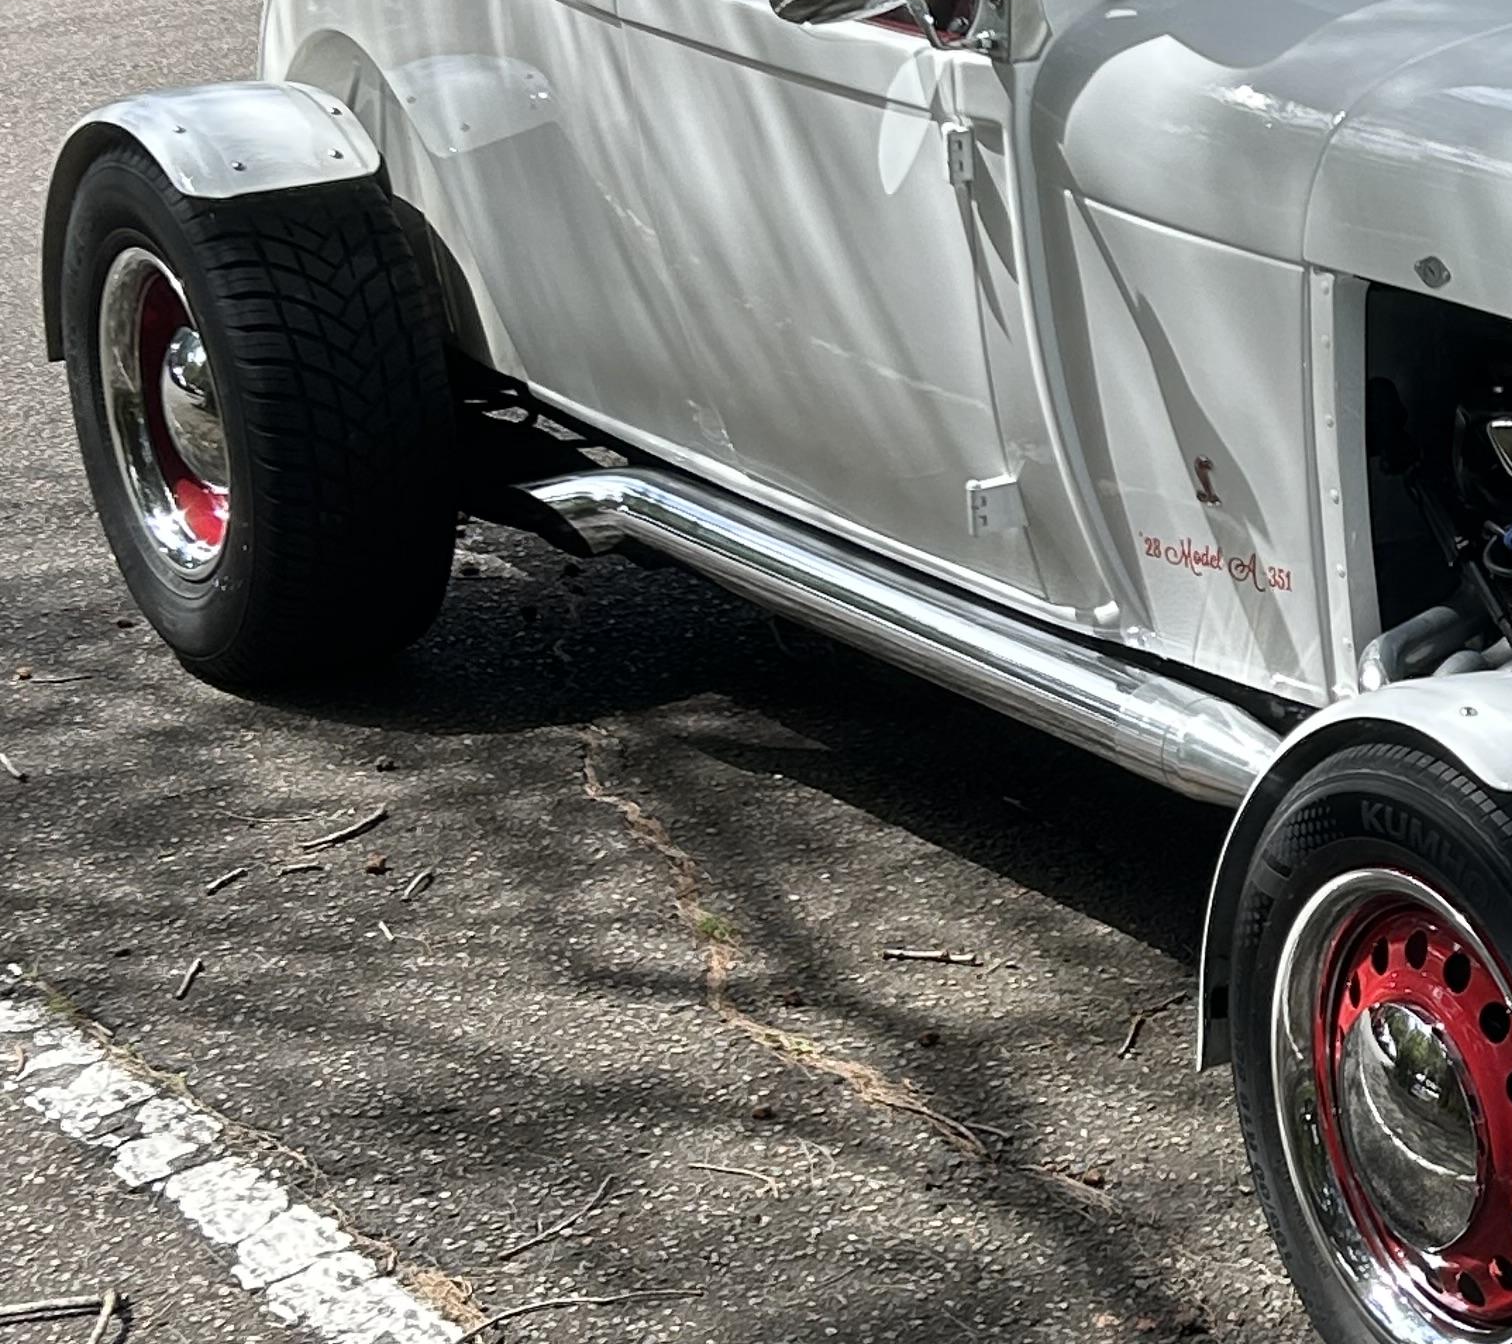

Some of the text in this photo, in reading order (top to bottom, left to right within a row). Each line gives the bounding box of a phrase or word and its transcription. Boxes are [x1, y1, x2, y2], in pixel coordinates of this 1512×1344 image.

[1165, 537, 1223, 576] Model
[1228, 554, 1265, 592] A
[1267, 566, 1292, 592] 351
[1360, 799, 1491, 911] KUMHO
